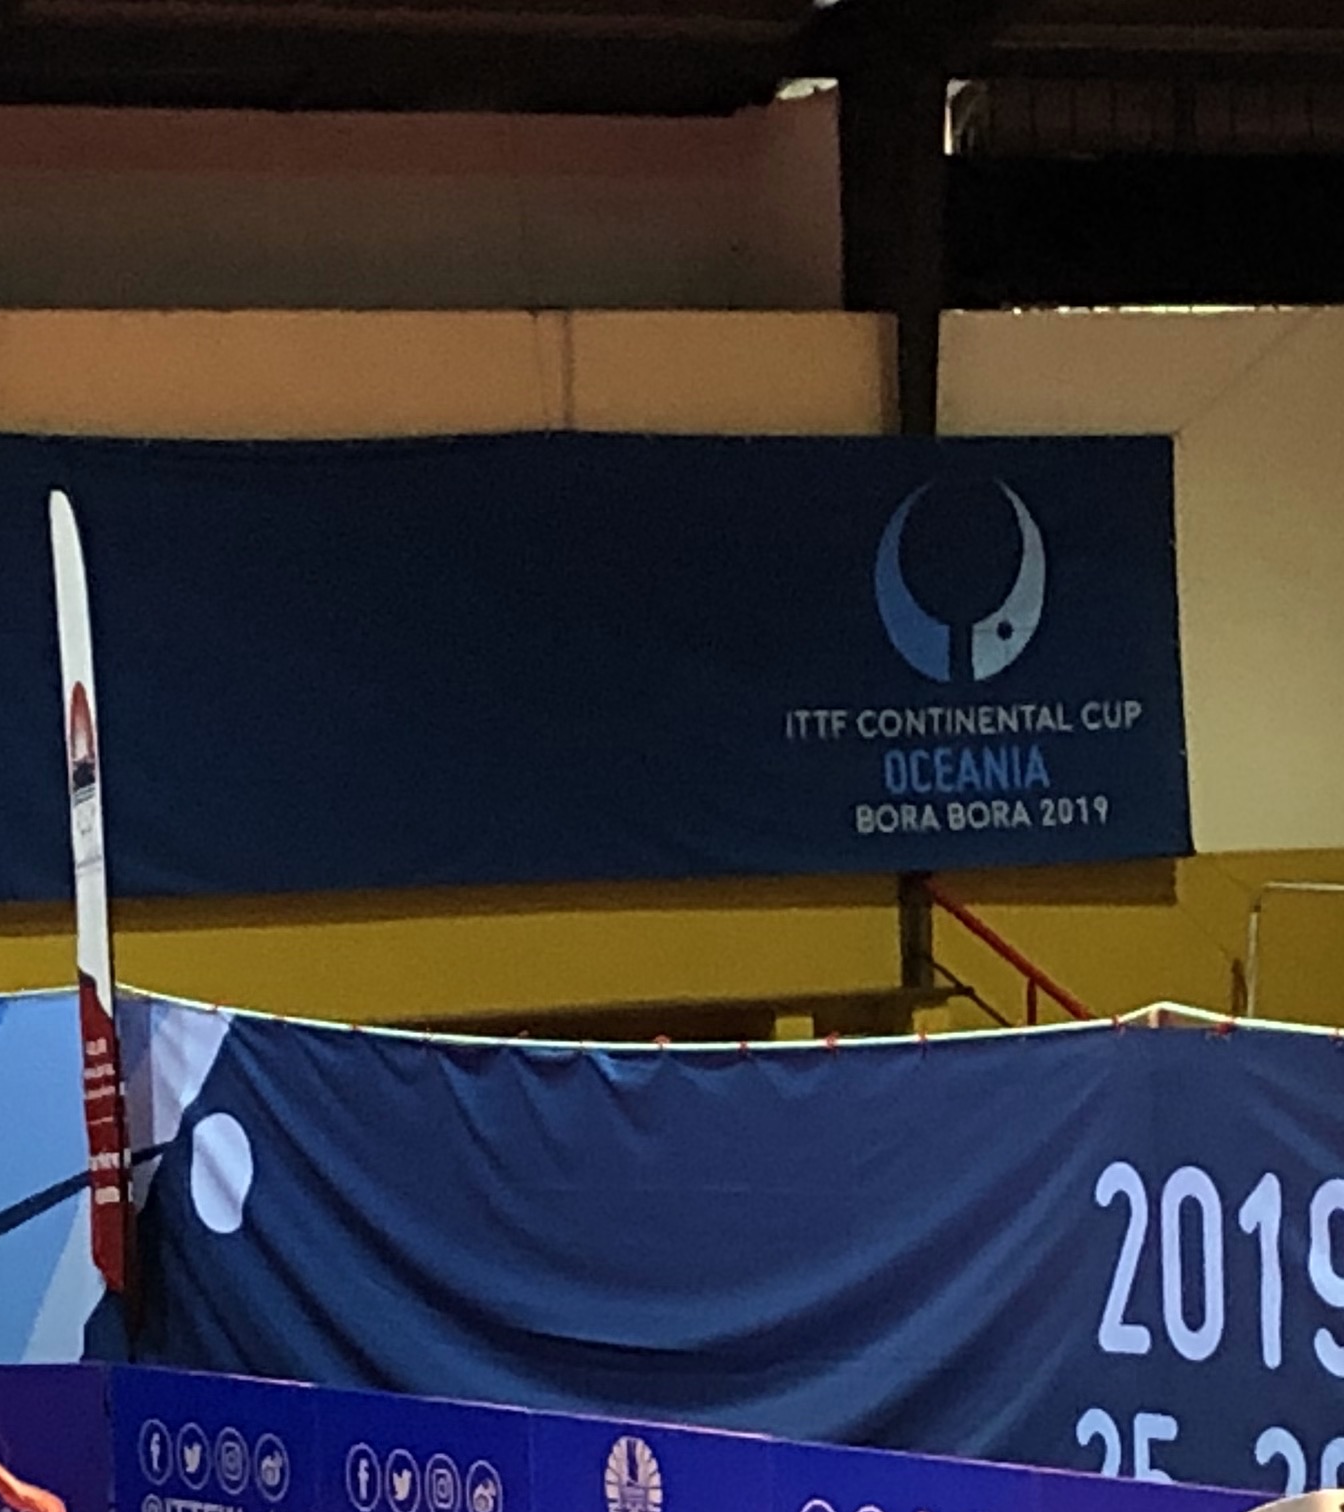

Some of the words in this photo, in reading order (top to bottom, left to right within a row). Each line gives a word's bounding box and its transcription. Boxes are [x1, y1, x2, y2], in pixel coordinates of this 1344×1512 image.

[785, 709, 847, 740] ITTF
[856, 702, 1073, 738] CONTINENTAL
[1080, 699, 1142, 730] CUP
[884, 745, 1050, 795] OCEANIA
[856, 804, 941, 833] BORA
[948, 799, 1030, 830] BORA
[1041, 795, 1109, 826] 2019
